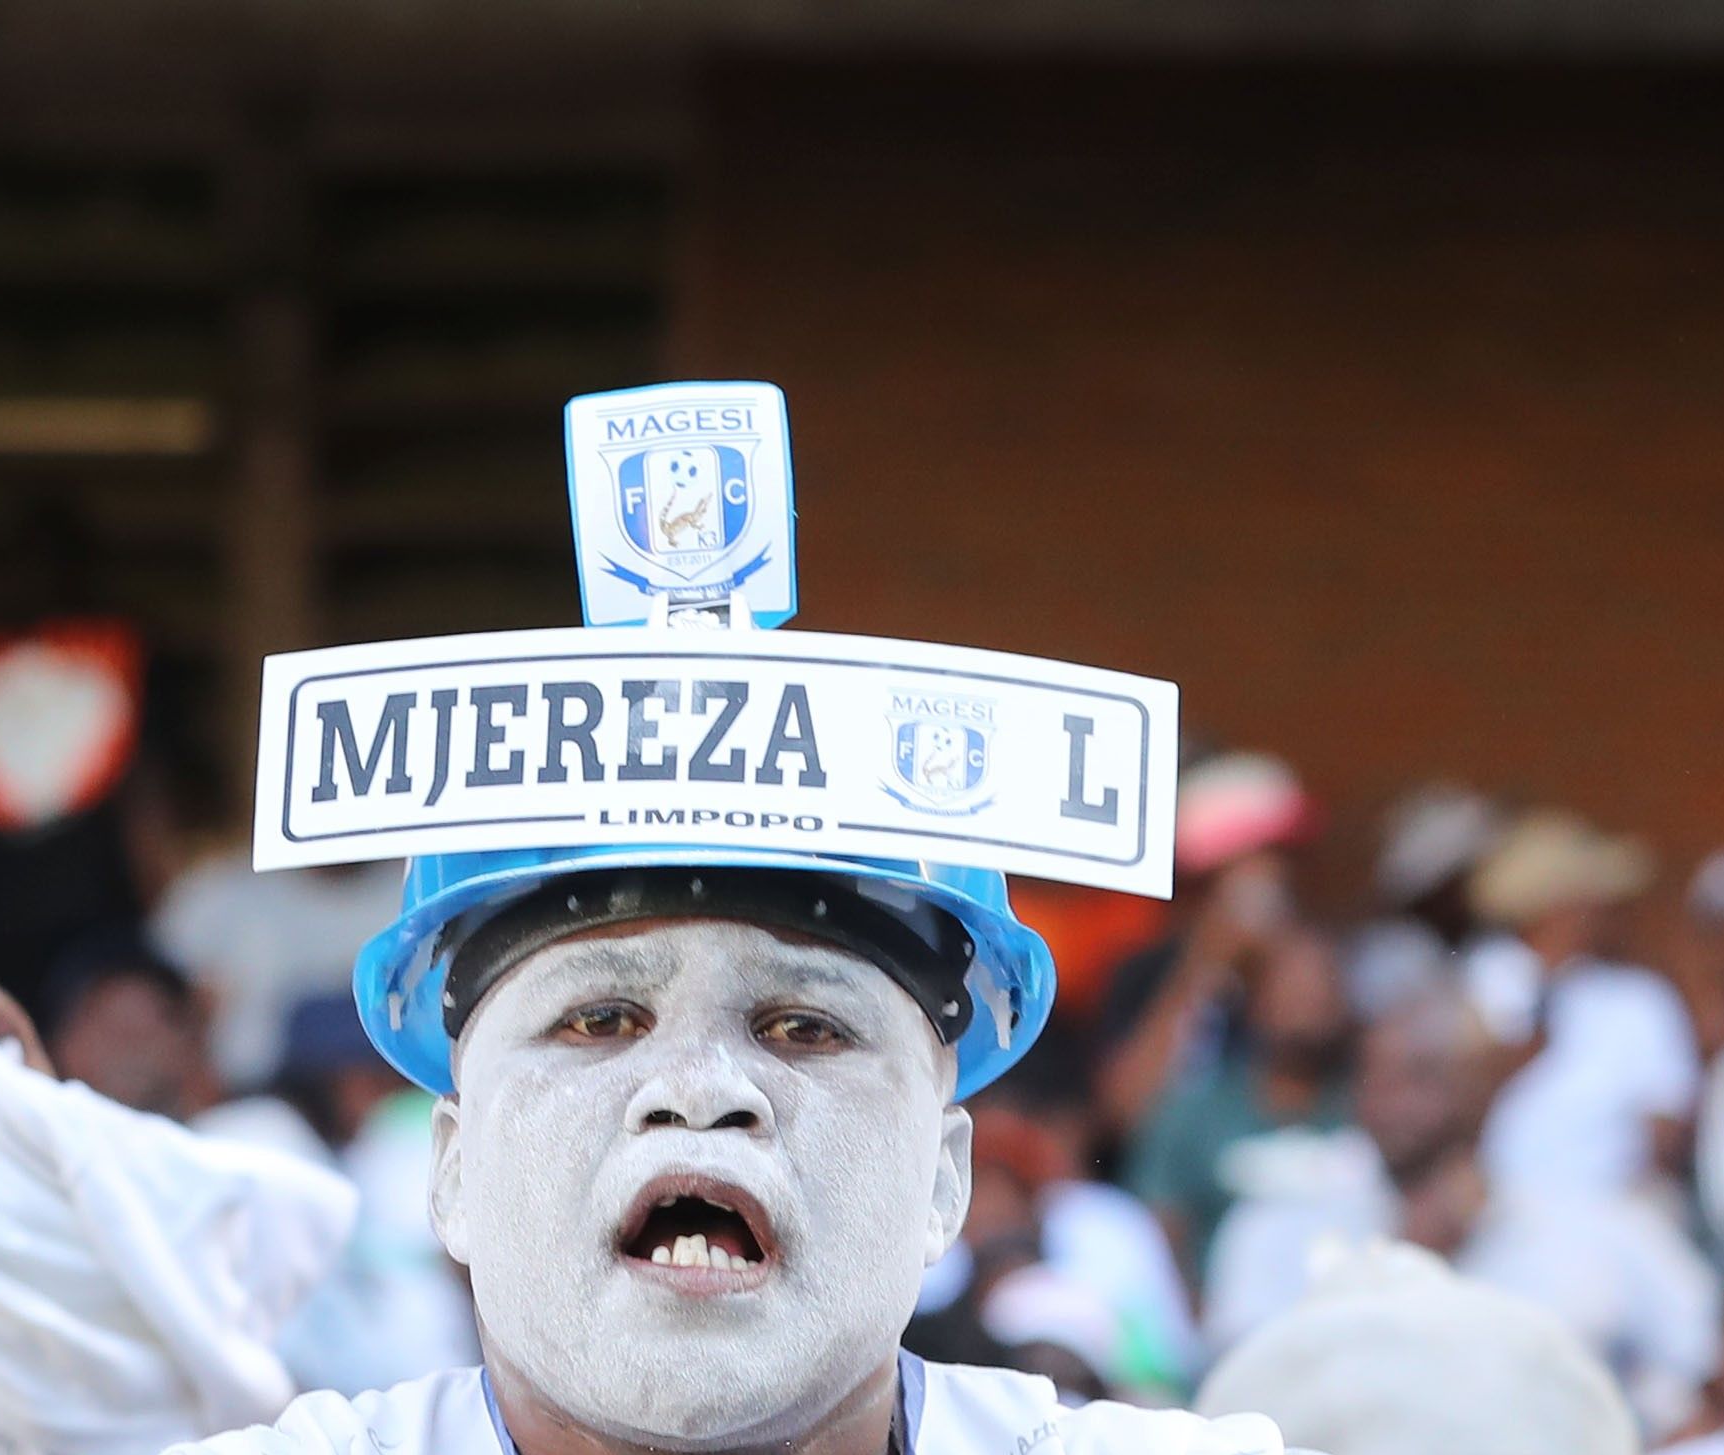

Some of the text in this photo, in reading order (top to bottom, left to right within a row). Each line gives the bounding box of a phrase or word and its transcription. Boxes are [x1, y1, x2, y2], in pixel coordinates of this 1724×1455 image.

[606, 408, 753, 441] MAGESI
[624, 478, 747, 515] F C
[891, 695, 994, 723] MAGESI
[310, 680, 1119, 827] MJEREZA L
[597, 808, 825, 832] LIMPOPO
